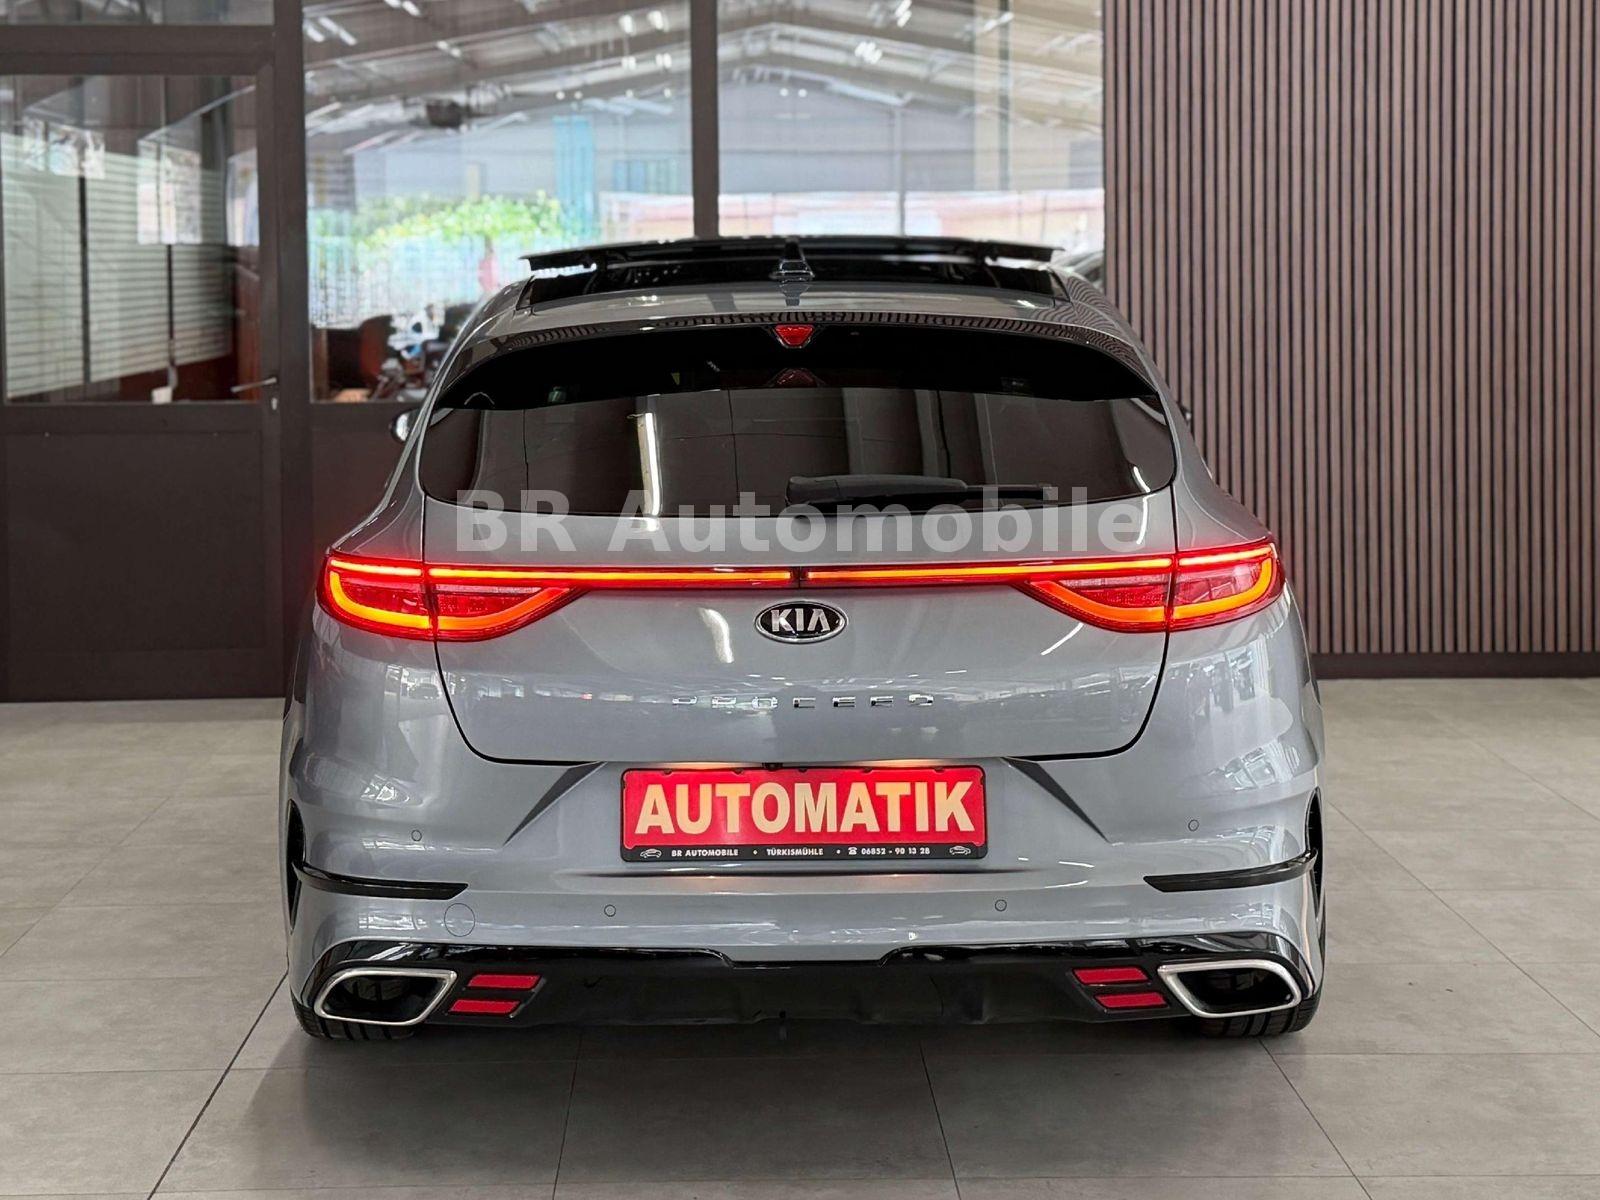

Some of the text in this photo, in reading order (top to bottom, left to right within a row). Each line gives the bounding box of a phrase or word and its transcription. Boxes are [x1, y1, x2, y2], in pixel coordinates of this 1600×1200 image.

[770, 608, 832, 633] KIA
[634, 781, 975, 834] AUTOMATIK
[671, 849, 682, 857] BR
[685, 848, 738, 857] AUTOMOBILE
[767, 848, 824, 856] TÜRKISMÜHLE
[861, 847, 886, 855] 06852
[895, 847, 905, 855] 90
[908, 847, 918, 855] 13
[919, 847, 931, 855] 28
